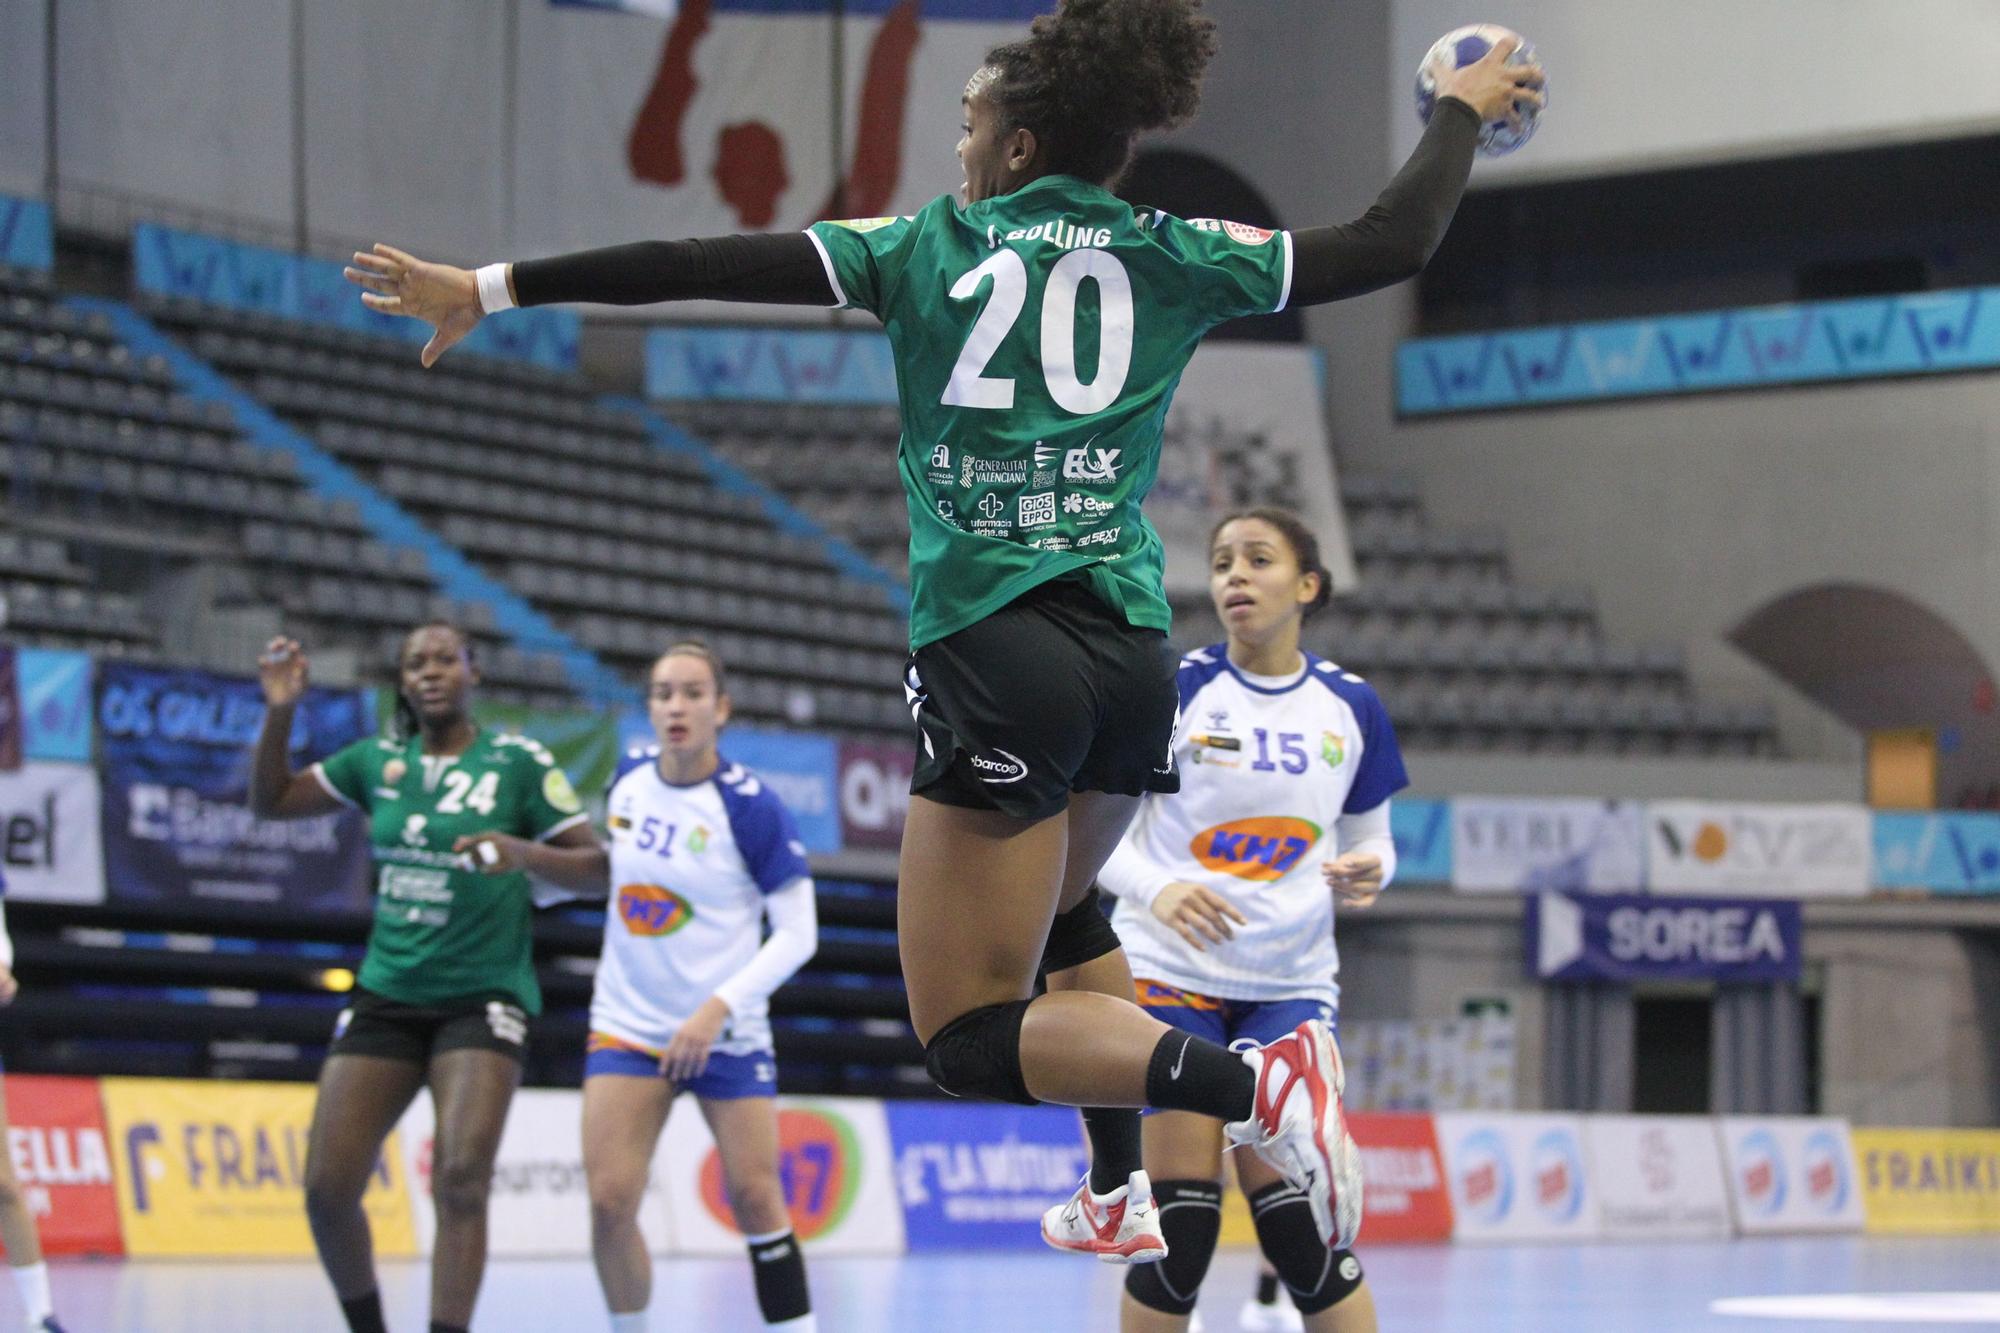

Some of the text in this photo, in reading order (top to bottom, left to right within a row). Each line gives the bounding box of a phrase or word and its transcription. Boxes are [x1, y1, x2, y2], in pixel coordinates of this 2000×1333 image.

[1004, 219, 1112, 250] BOLLING
[940, 249, 1134, 415] 20
[975, 459, 1028, 472] GENERALITAT
[975, 471, 1028, 484] VALENCIANA
[1021, 509, 1053, 525] EPPO
[1022, 495, 1053, 512] GIOS
[1090, 526, 1122, 543] SEXY
[1252, 727, 1309, 775] 15
[435, 769, 500, 816] 24
[636, 816, 676, 859] 51
[1209, 830, 1308, 873] KH7
[1607, 906, 1785, 964] SOREA
